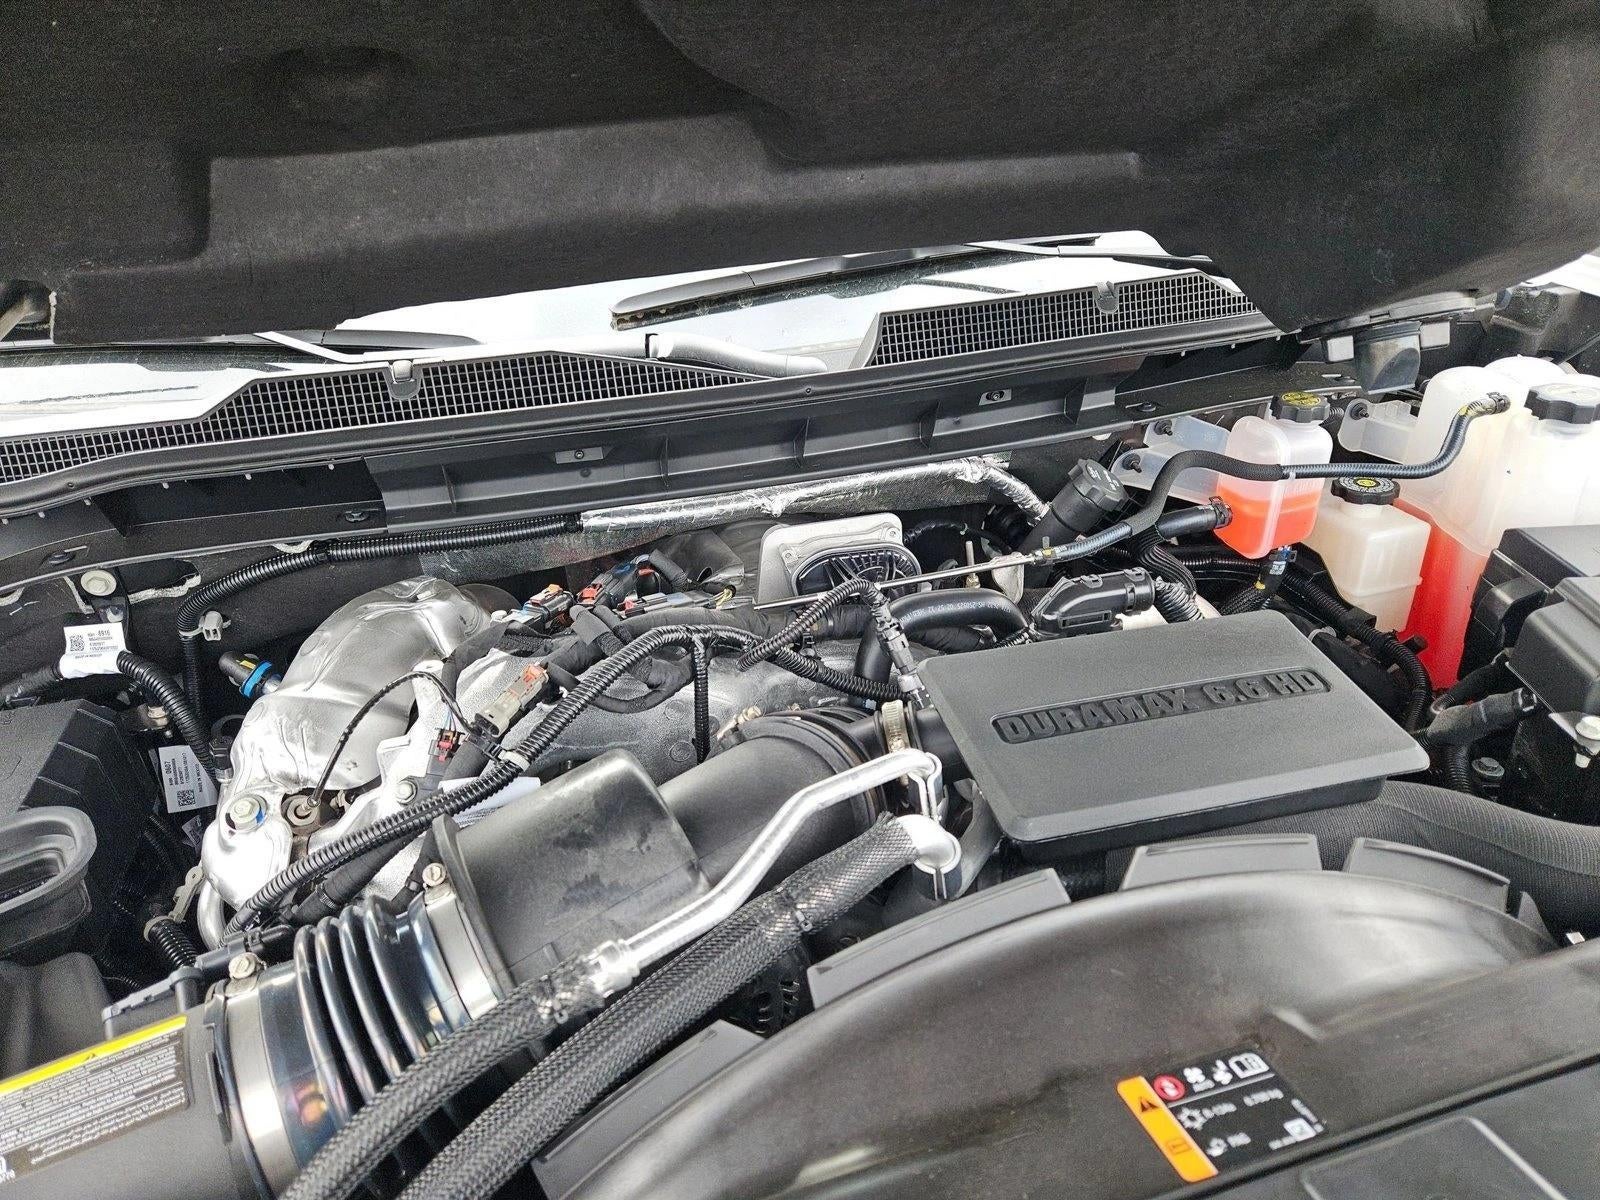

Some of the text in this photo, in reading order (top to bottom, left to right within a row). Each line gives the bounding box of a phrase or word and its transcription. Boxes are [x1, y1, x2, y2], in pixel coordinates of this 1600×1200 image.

[998, 668, 1325, 742] DURAMAX 6.6 HD
